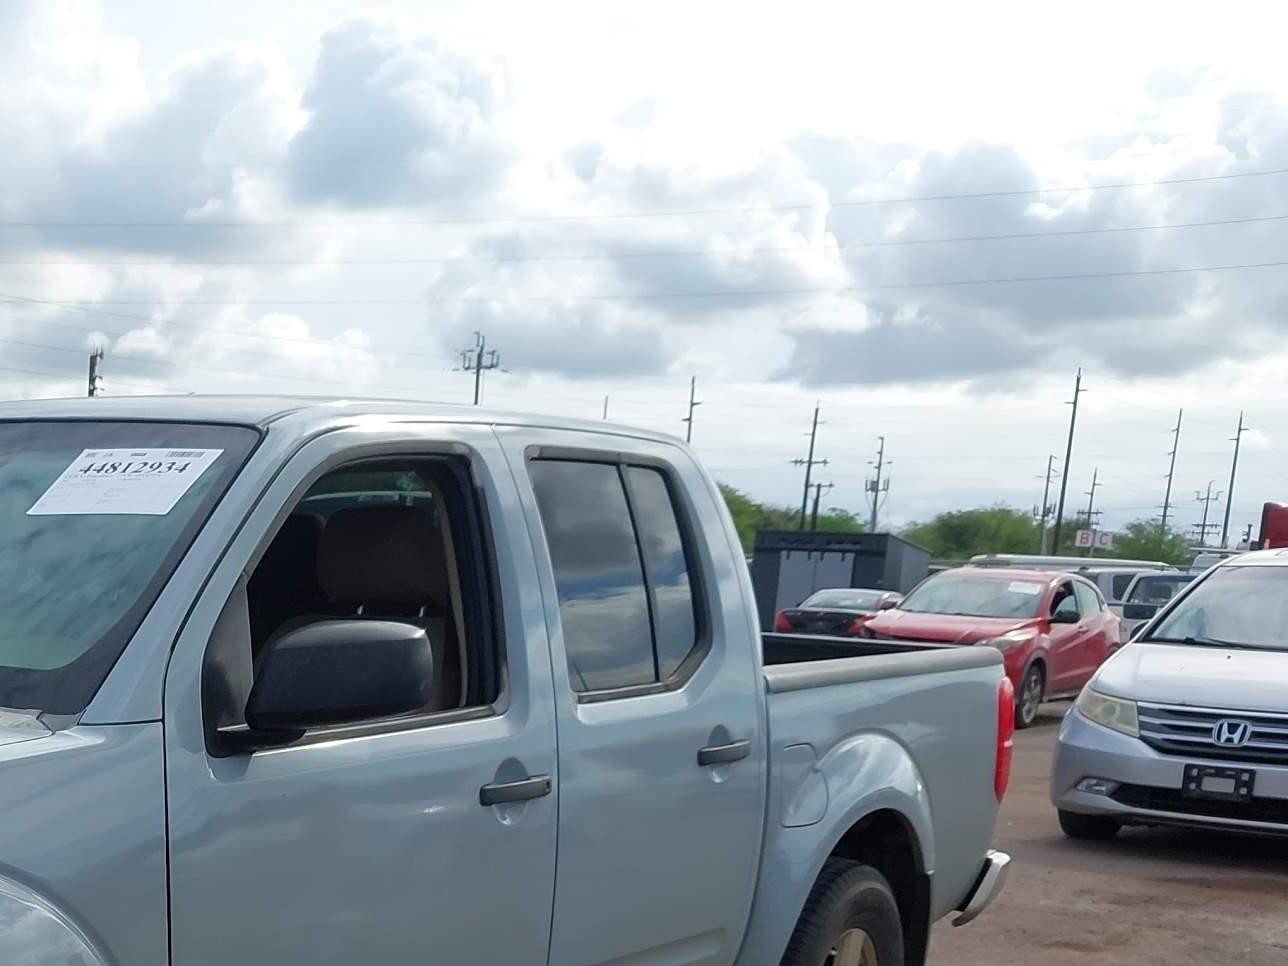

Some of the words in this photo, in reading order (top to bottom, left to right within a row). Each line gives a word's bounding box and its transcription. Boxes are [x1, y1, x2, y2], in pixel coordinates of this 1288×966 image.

[79, 461, 192, 474] 44812934
[1079, 532, 1090, 545] B
[1099, 533, 1110, 545] C
